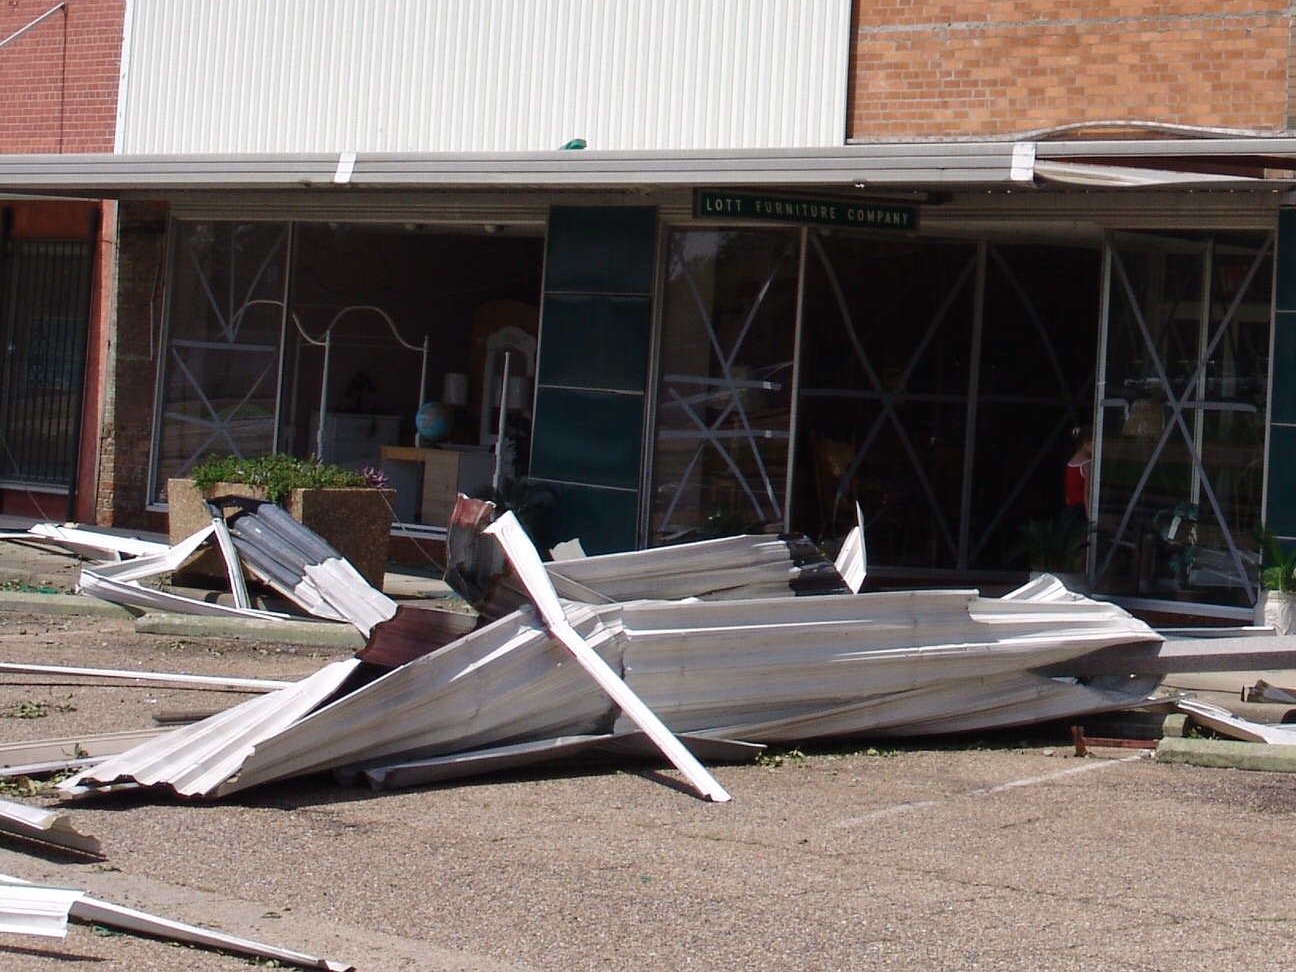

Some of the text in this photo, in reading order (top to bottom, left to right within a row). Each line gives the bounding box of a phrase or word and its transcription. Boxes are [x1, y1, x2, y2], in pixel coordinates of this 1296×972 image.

[706, 197, 909, 225] LOTT FURNITURE COMPANY
